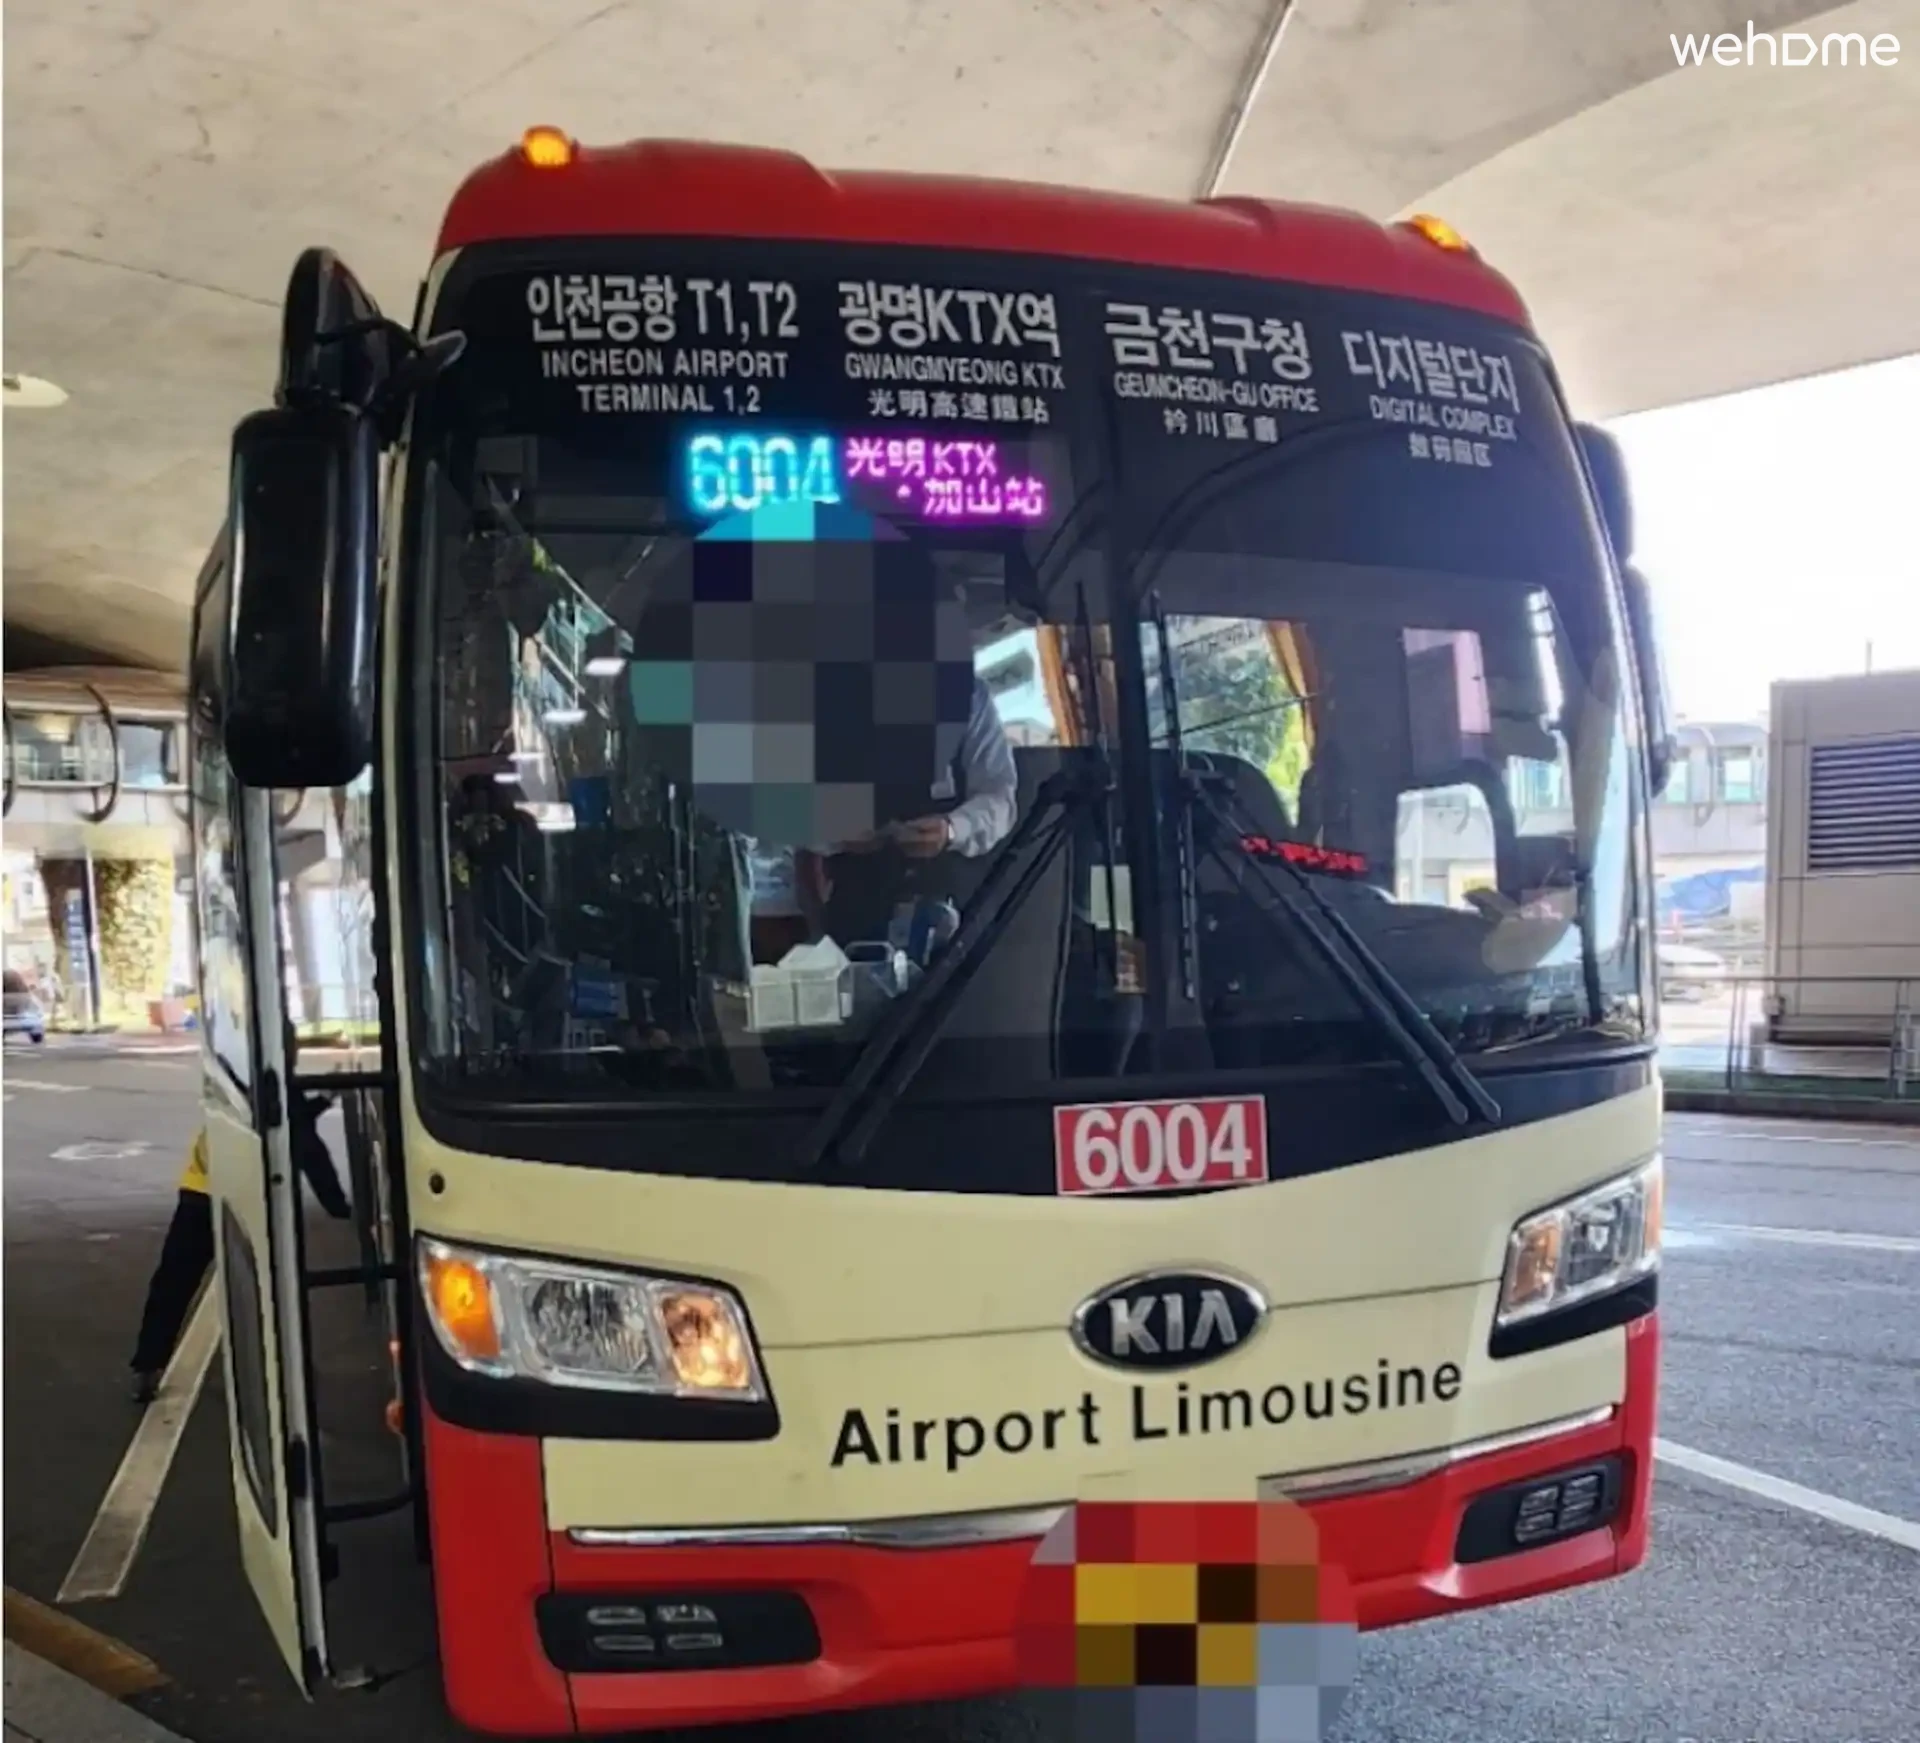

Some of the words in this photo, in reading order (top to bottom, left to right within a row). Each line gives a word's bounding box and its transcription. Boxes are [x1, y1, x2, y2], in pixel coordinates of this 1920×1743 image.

[526, 274, 679, 342] 인천공항
[686, 279, 800, 343] T1,T2
[838, 279, 1061, 358] 광명KTX역
[1104, 302, 1312, 381] 금천구청
[541, 348, 664, 378] INCHEON
[673, 350, 789, 379] AIRPORT
[576, 383, 714, 413] TERMINAL
[844, 352, 1019, 386] GWANGMYEONG
[1020, 361, 1066, 390] KTX
[1113, 371, 1258, 408] GEUMCHEON-GU
[1259, 382, 1321, 413] OFFICE
[1340, 329, 1521, 414] 디지털단지
[1369, 394, 1440, 428] DIGITAL
[1440, 404, 1518, 442] COMPLEX
[688, 434, 841, 511] 6004
[1073, 1103, 1253, 1189] 6004
[1108, 1288, 1238, 1356] KIA
[830, 1392, 1101, 1473] Airport
[1132, 1359, 1462, 1442] Limousine
